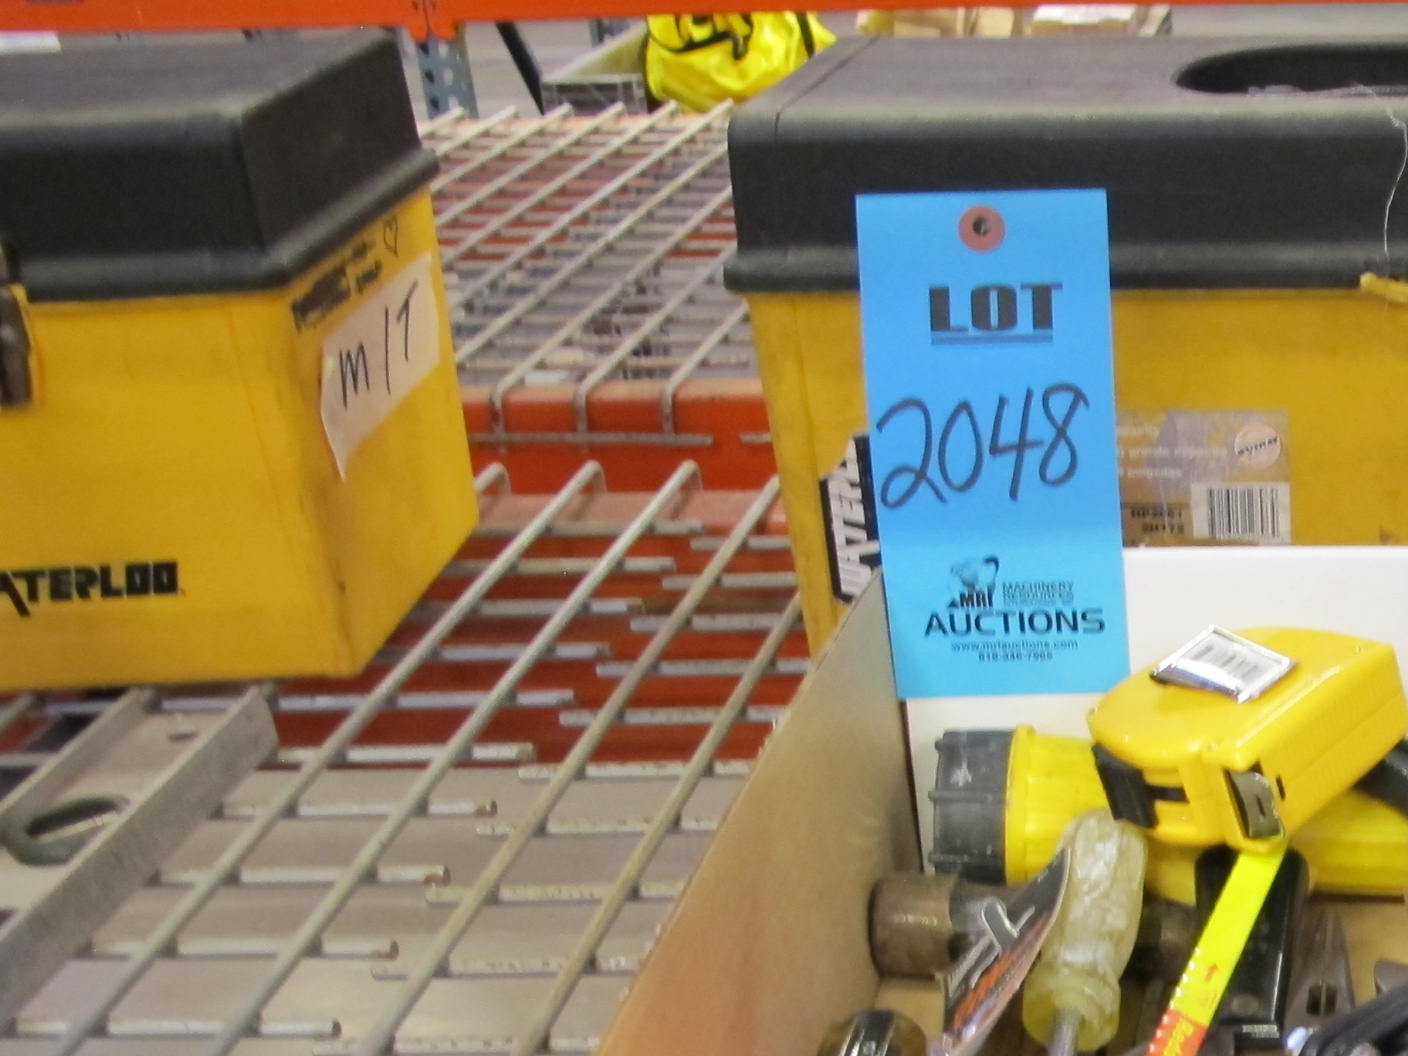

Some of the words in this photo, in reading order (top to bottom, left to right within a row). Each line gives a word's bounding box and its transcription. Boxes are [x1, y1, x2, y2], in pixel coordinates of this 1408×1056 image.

[929, 282, 1063, 332] LOT
[876, 383, 1090, 509] 2048
[924, 607, 1105, 637] AUCTIONS
